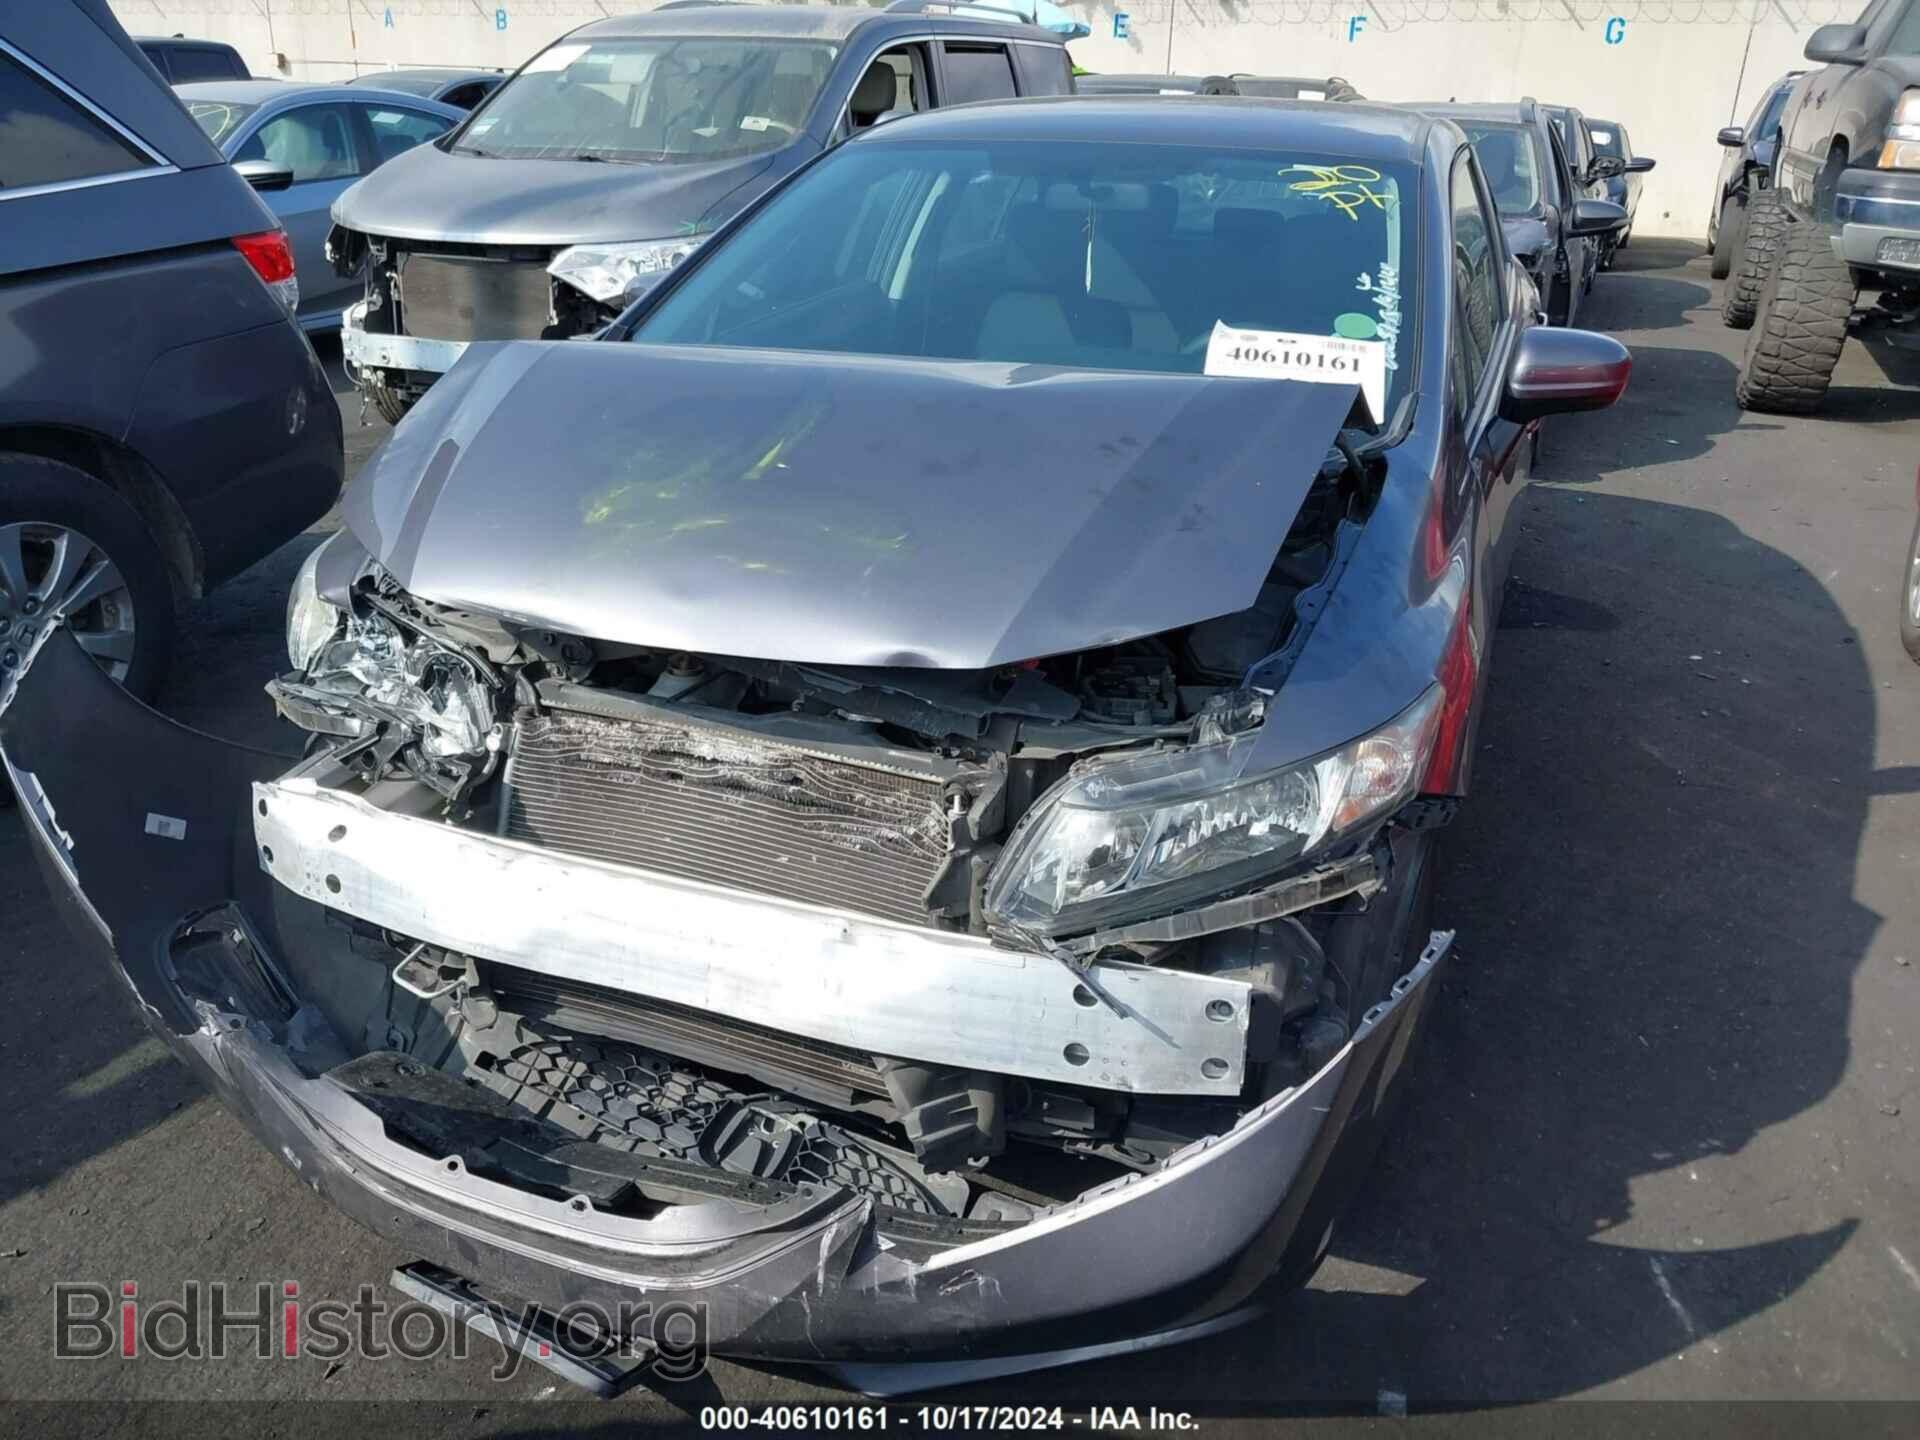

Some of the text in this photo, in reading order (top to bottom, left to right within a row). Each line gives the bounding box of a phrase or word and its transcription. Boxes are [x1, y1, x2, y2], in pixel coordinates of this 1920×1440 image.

[384, 7, 395, 29] A
[495, 8, 508, 31] B
[1113, 12, 1129, 39] E
[1348, 16, 1368, 43] F
[1605, 16, 1626, 45] G
[1226, 346, 1361, 373] 40610161
